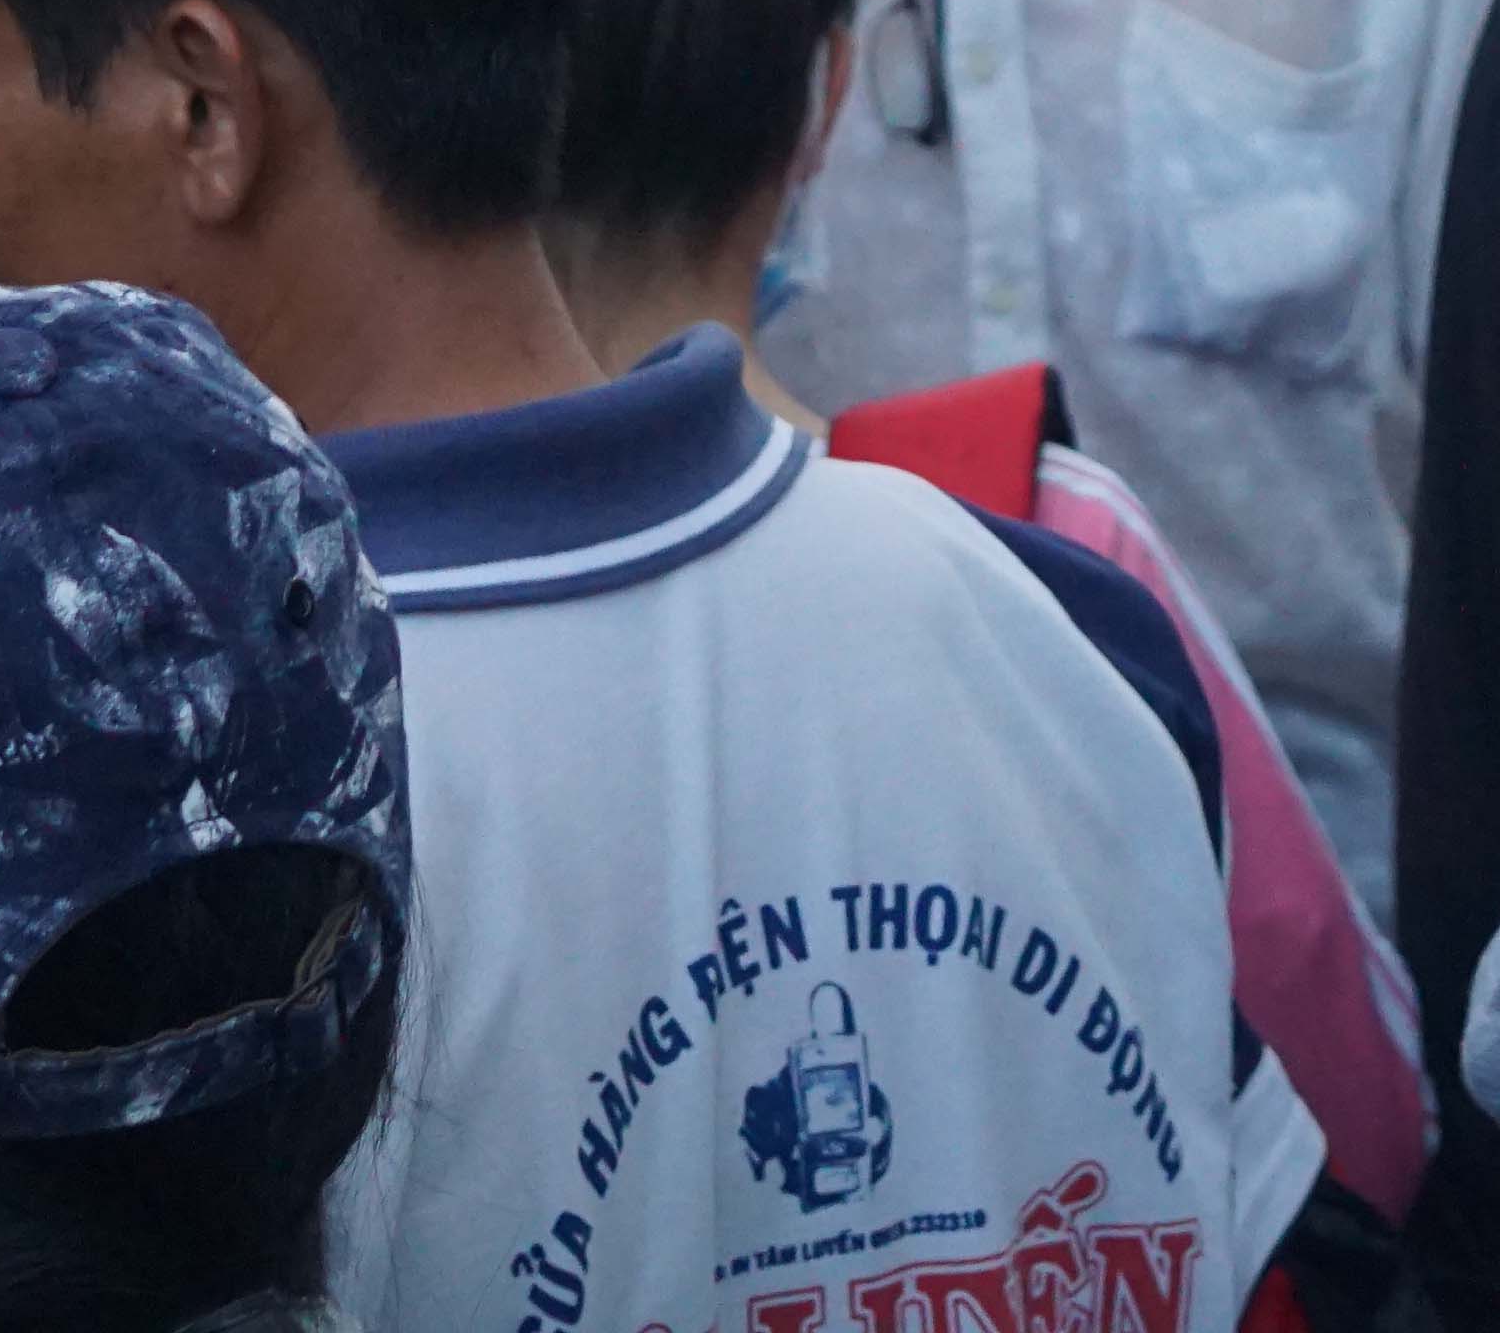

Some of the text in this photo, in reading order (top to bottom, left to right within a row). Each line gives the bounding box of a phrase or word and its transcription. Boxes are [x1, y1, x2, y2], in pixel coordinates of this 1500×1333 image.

[510, 1210, 593, 1333] ỬA
[577, 994, 693, 1200] HÀNG
[1011, 926, 1081, 1016] DI
